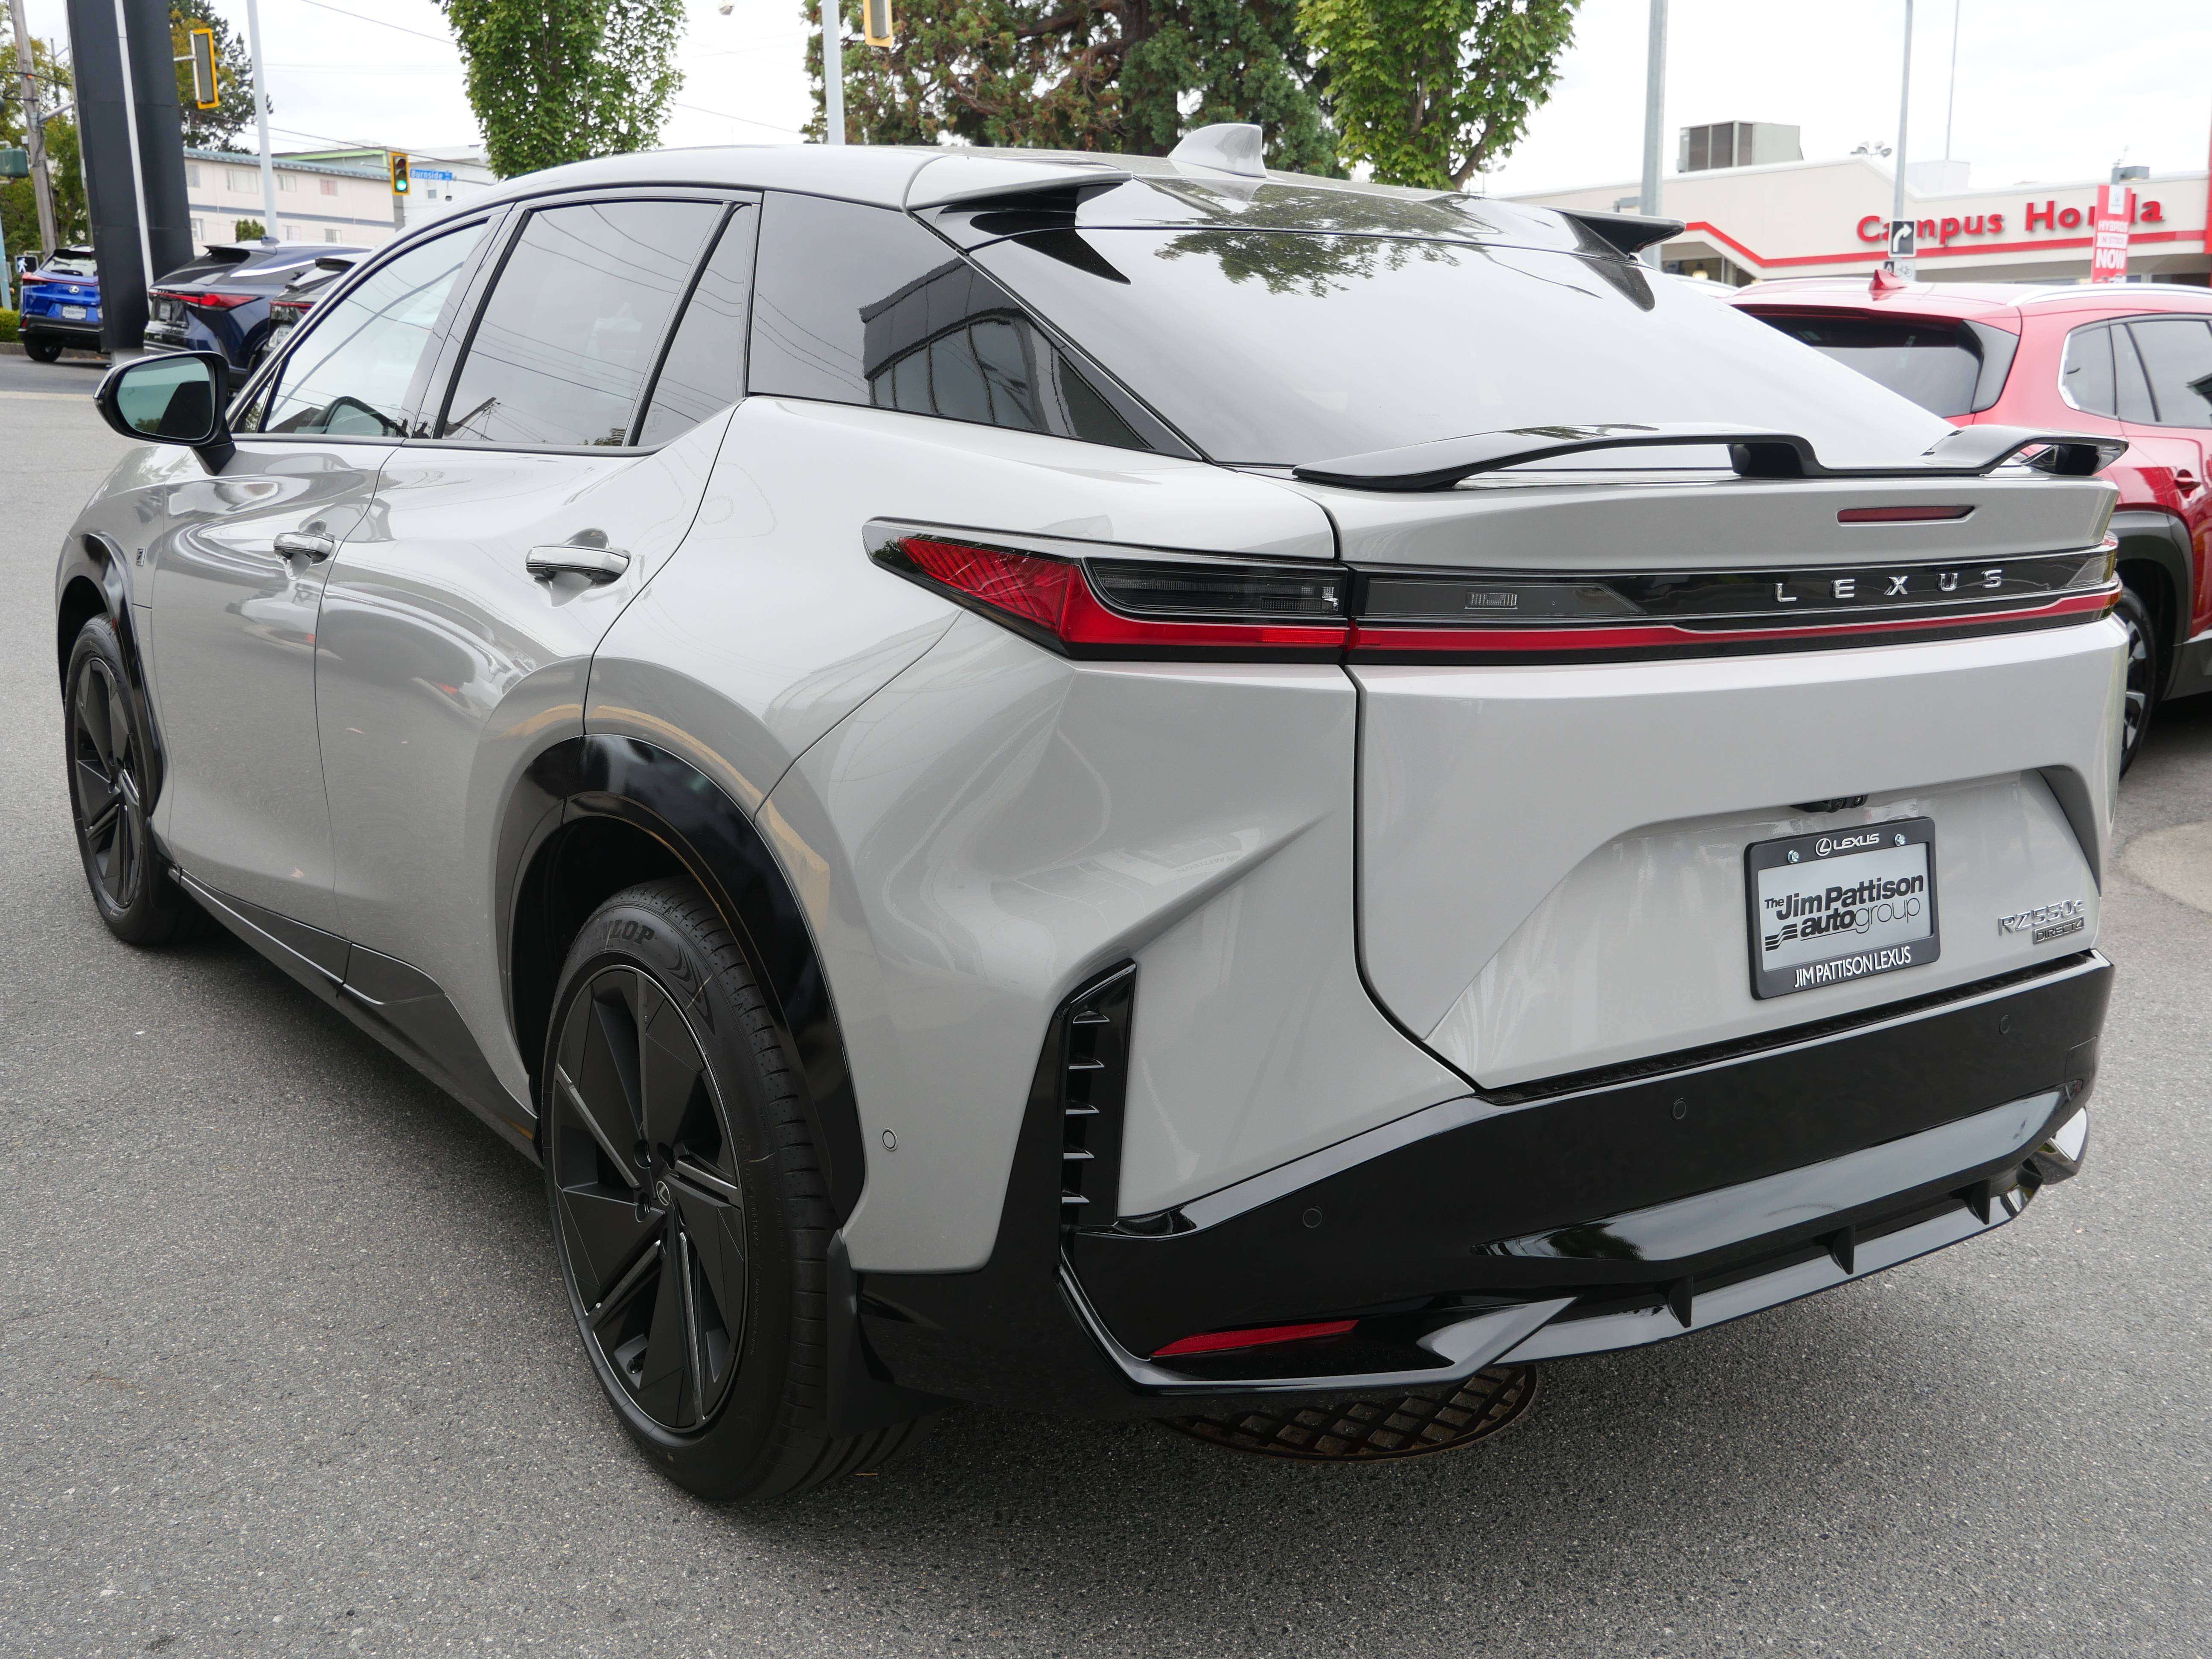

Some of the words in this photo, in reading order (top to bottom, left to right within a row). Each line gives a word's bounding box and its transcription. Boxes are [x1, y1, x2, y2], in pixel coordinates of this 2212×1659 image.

[411, 170, 443, 179] Burnside
[2026, 194, 2163, 231] Hoa
[2098, 220, 2128, 232] HYBRIDS
[2110, 237, 2124, 245] STOCK
[2096, 249, 2126, 269] NOW
[1774, 569, 2002, 602] LEXUS
[1833, 833, 1879, 850] LEXUS
[1765, 898, 1784, 909] The
[2037, 917, 2084, 942] DIRECT4
[1795, 969, 1814, 988] JIM
[1816, 955, 1872, 983] PATTISON
[1874, 946, 1911, 970] LEXUS
